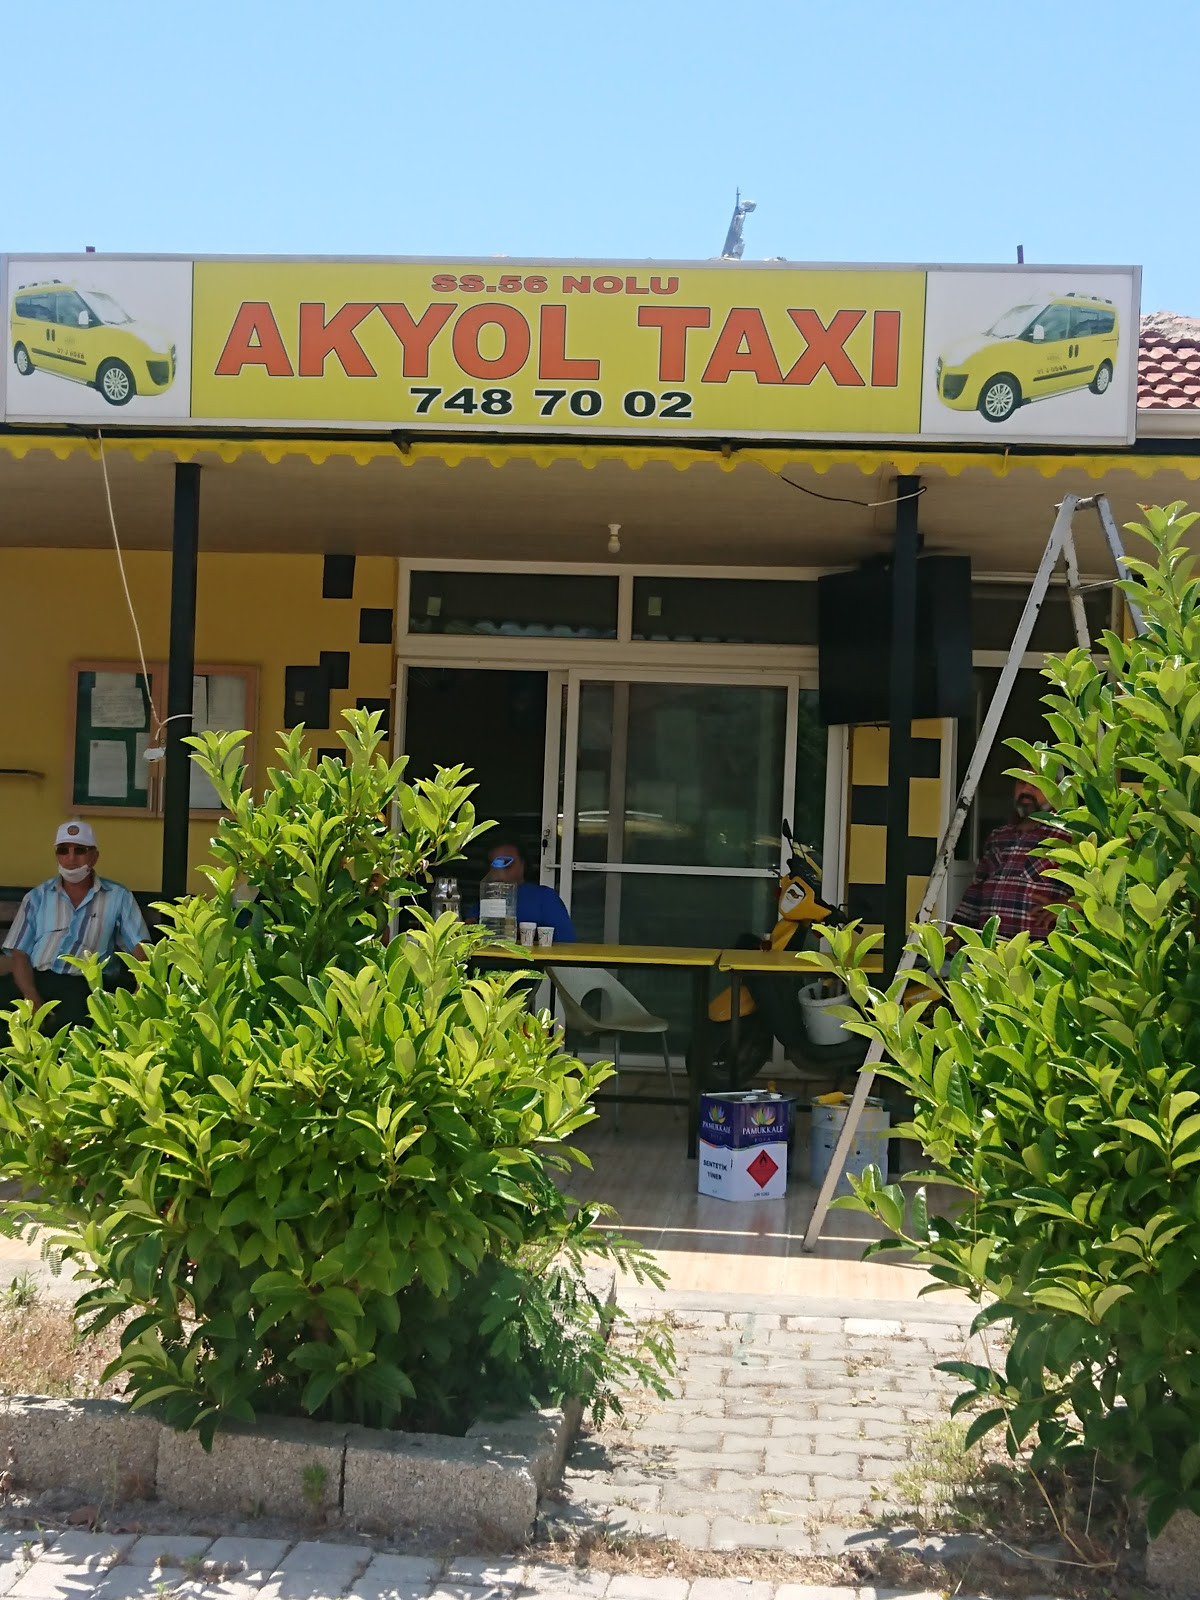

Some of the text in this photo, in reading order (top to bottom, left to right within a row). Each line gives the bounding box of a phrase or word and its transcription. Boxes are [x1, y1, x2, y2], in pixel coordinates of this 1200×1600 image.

[431, 274, 679, 295] SS.56 NOLU
[214, 301, 901, 388] AKYOL TAXI
[410, 387, 693, 419] 748 70 02
[702, 1121, 731, 1134] PAMUKKALE
[742, 1126, 783, 1135] PAMUKKALE
